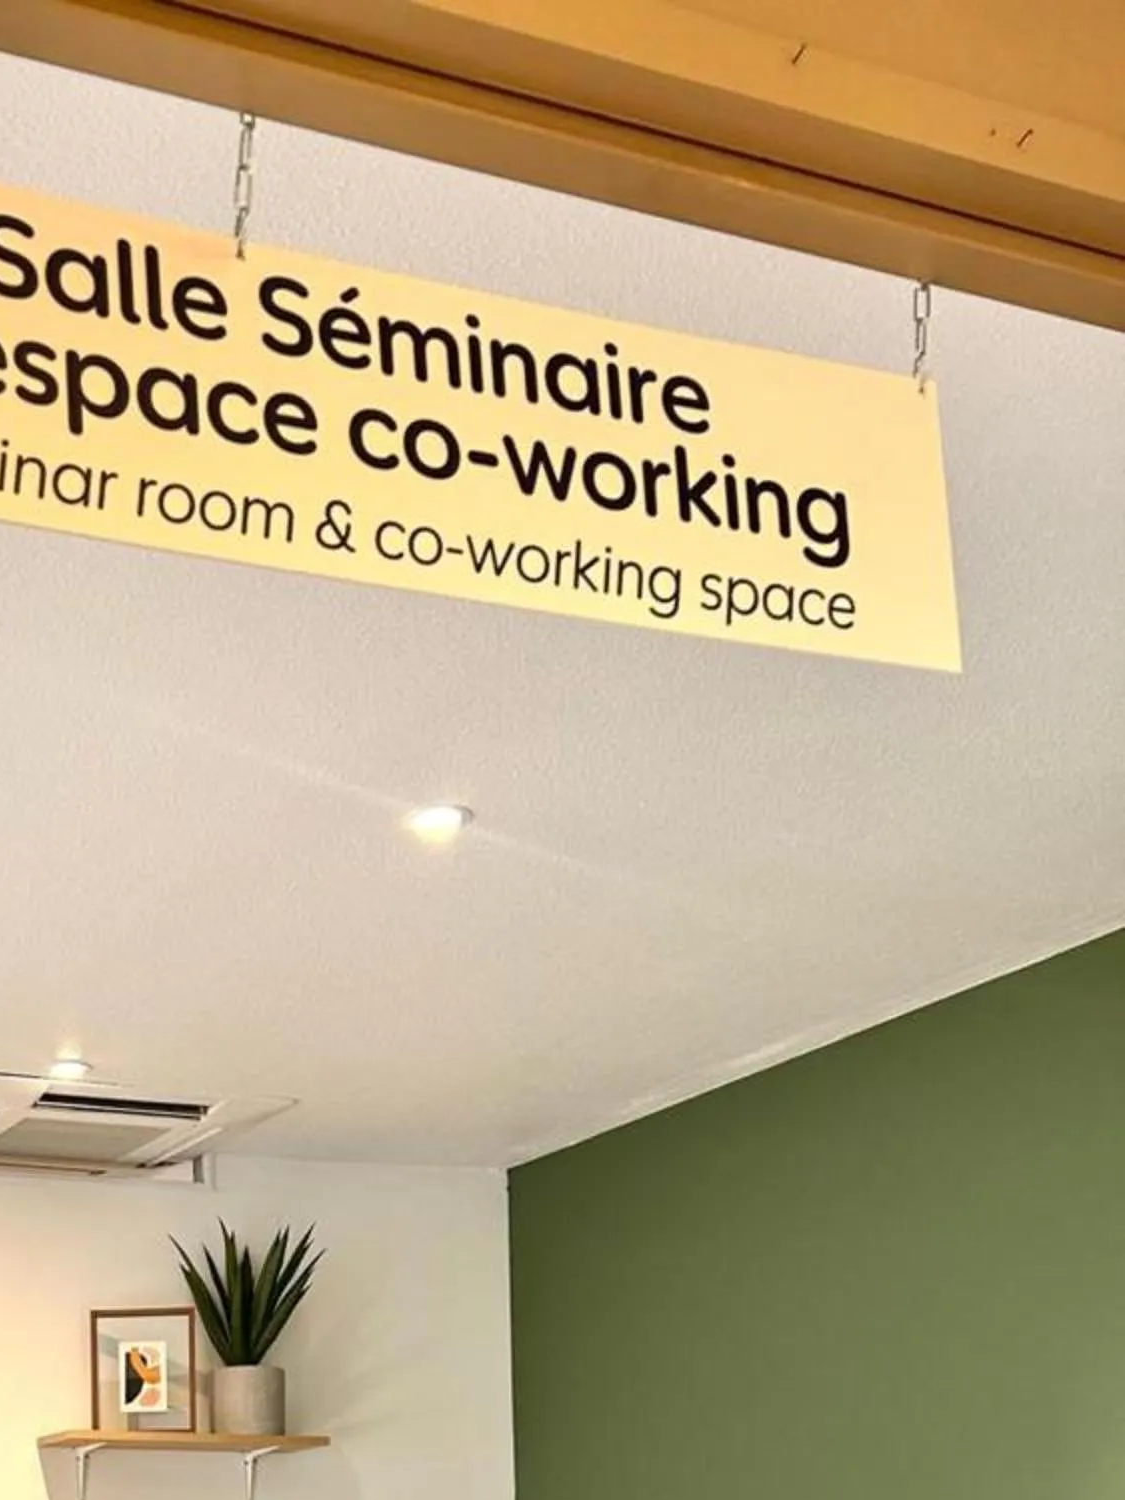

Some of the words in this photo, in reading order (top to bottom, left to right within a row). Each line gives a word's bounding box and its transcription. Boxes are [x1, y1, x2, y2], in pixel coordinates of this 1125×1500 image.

[257, 275, 711, 436] Séminaire
[136, 477, 295, 544] room
[314, 498, 357, 554] &
[373, 520, 683, 620] co-working
[700, 572, 857, 631] space
[347, 407, 851, 570] co-working
